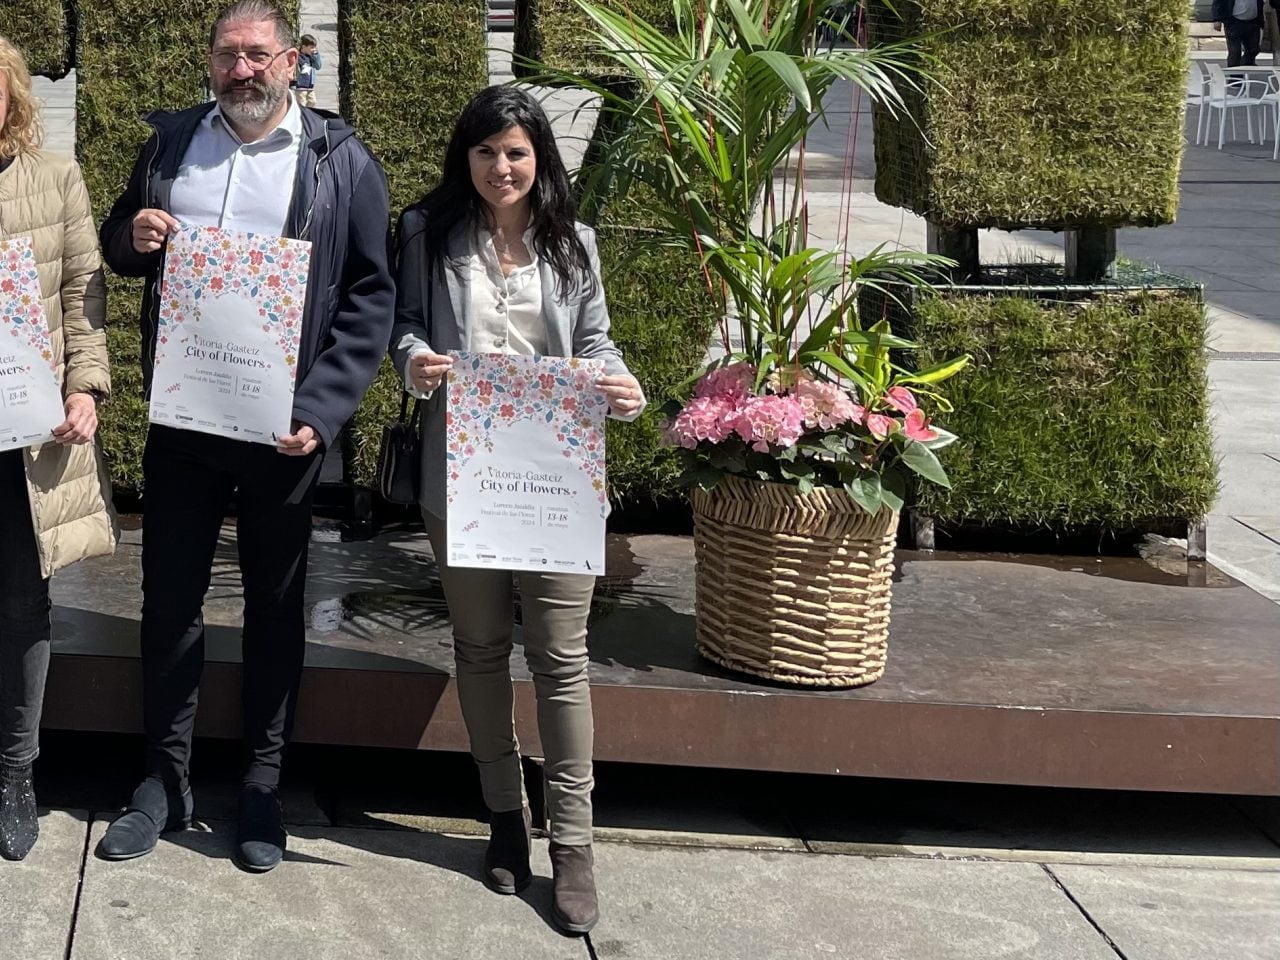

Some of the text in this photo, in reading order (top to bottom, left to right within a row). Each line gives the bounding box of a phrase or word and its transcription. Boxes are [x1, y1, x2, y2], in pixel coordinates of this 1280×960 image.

[186, 346, 266, 369] City of Flowers
[481, 479, 571, 496] City of Flowers
